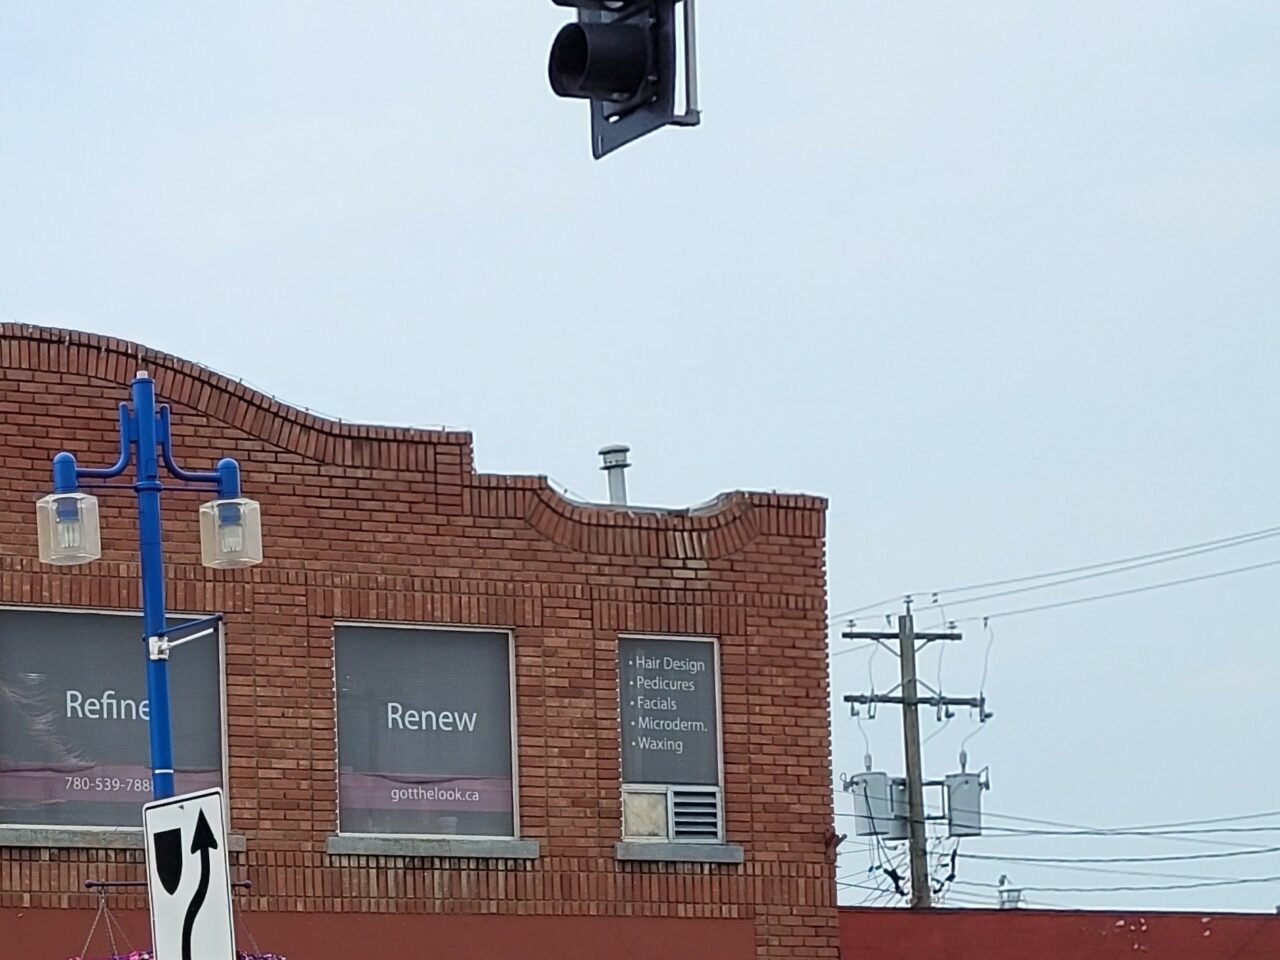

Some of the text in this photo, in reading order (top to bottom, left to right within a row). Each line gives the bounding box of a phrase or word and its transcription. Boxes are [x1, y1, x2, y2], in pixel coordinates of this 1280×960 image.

[635, 655, 705, 674] Hair Design
[636, 676, 695, 691] Pedicures
[66, 690, 151, 721] Refine
[637, 696, 678, 711] Facials
[387, 702, 477, 732] Renew
[638, 716, 708, 732] Microderm.
[637, 736, 684, 754] Waxing
[64, 776, 154, 792] 780-539-788
[391, 786, 480, 802] gotthelook.ca
